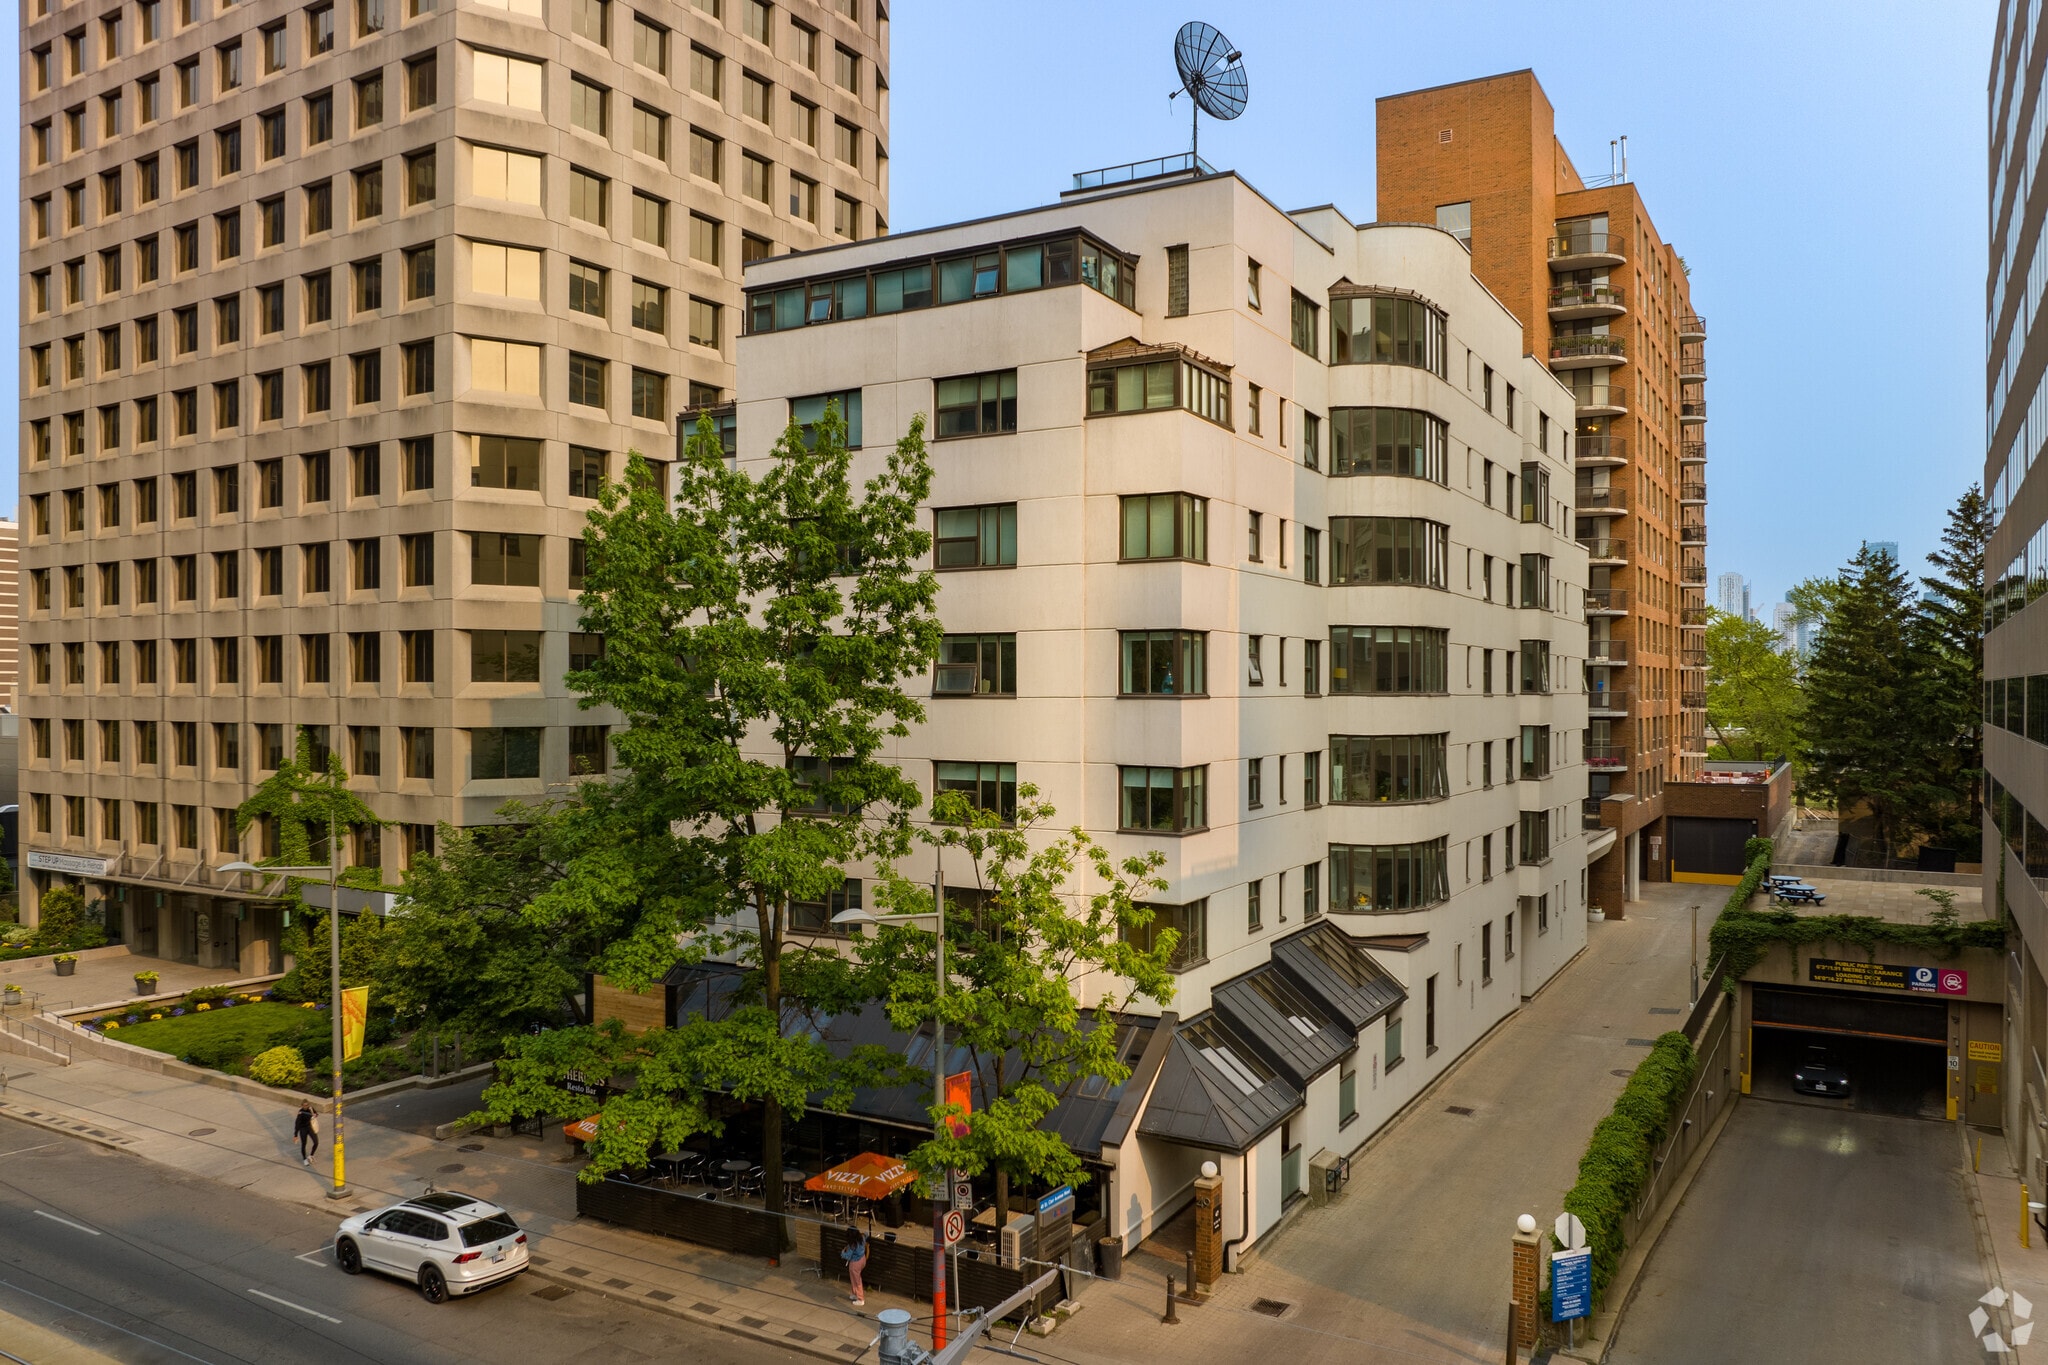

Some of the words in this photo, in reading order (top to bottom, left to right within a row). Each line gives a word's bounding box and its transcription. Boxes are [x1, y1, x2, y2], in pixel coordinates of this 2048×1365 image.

[1857, 963, 1884, 971] PARNG
[1835, 972, 1863, 980] LOADING
[1867, 969, 1904, 978] CEARANCE
[1970, 1042, 2000, 1051] CAUTION
[566, 1081, 585, 1093] Resto
[586, 1085, 597, 1096] Bar
[827, 1170, 871, 1185] VIZZY
[875, 1163, 907, 1183] VIZZY
